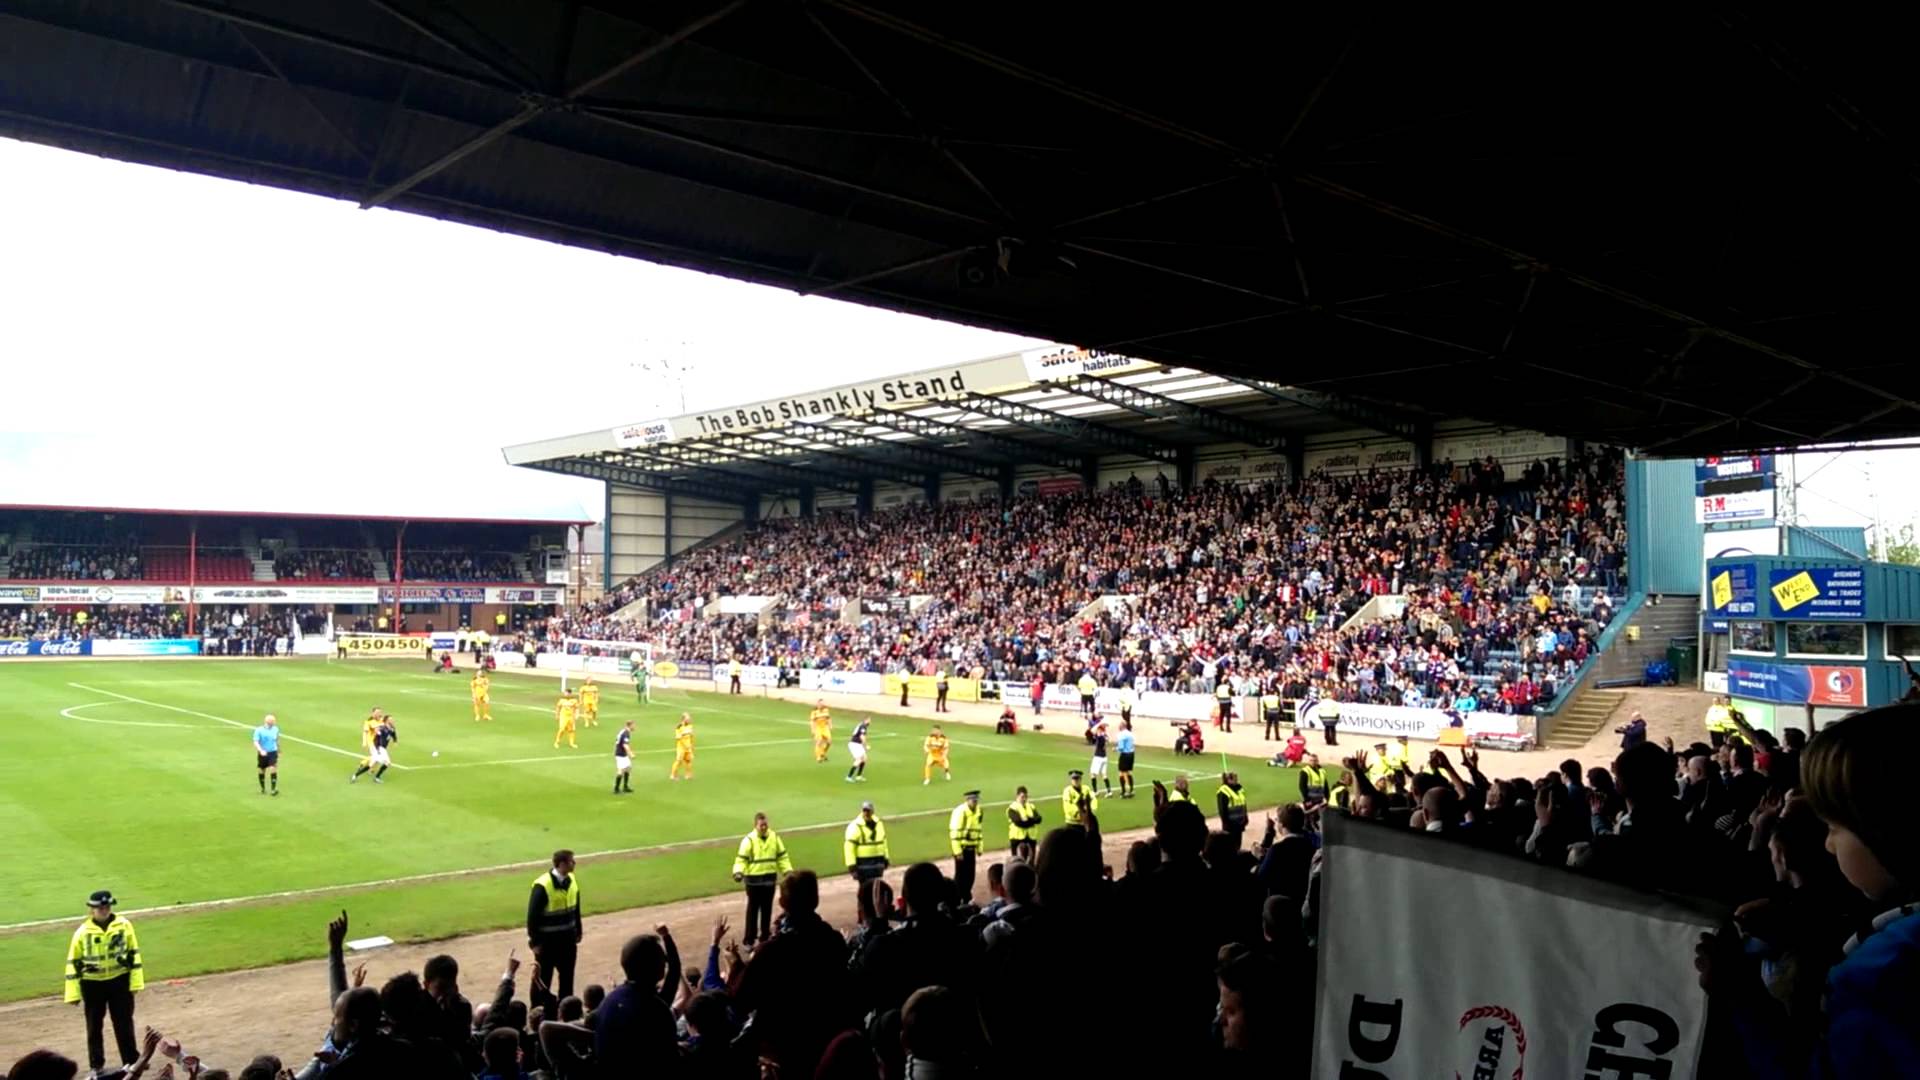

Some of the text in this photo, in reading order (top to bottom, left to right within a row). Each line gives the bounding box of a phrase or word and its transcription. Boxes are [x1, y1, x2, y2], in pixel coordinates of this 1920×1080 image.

[1082, 357, 1131, 371] habitats
[696, 370, 965, 432] The Bob Shankly Stand
[40, 640, 82, 656] Coca-Cola
[349, 639, 420, 650] 450450
[1338, 714, 1426, 732] AMPIONSHIP
